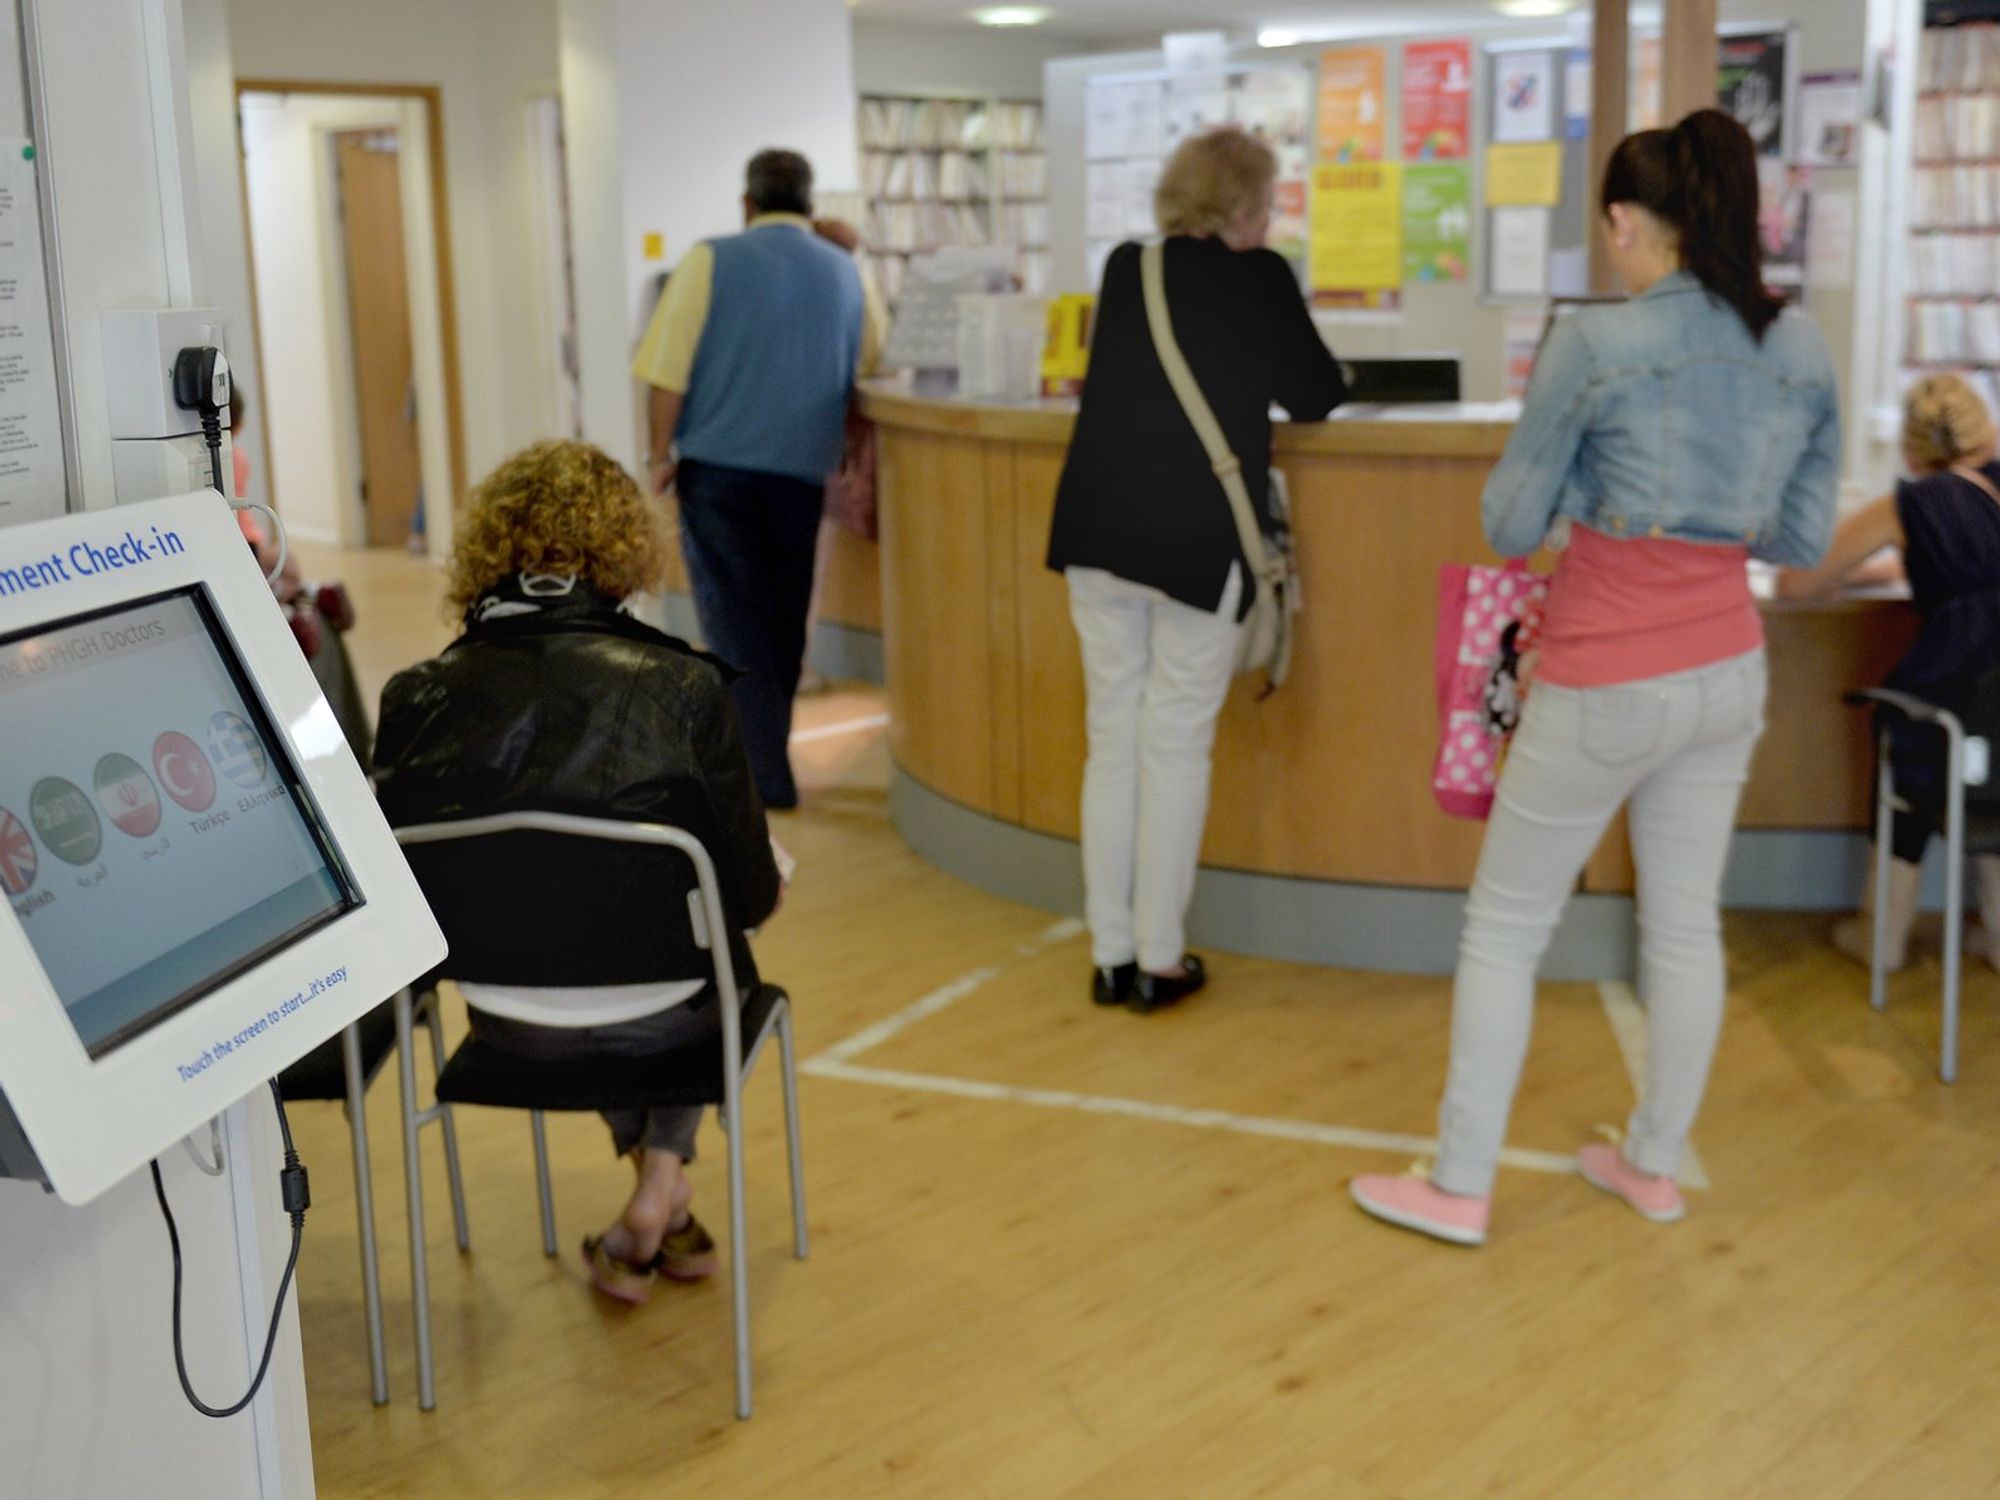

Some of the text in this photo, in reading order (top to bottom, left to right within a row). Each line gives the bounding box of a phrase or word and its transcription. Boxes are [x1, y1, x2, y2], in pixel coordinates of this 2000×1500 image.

[69, 526, 185, 576] Check-in
[47, 636, 101, 666] PHGH
[100, 619, 166, 651] Doctors
[177, 1050, 214, 1083] Touch
[212, 1041, 234, 1060] the
[233, 1018, 269, 1048] screen
[267, 1010, 280, 1025] to
[325, 966, 347, 988] easy
